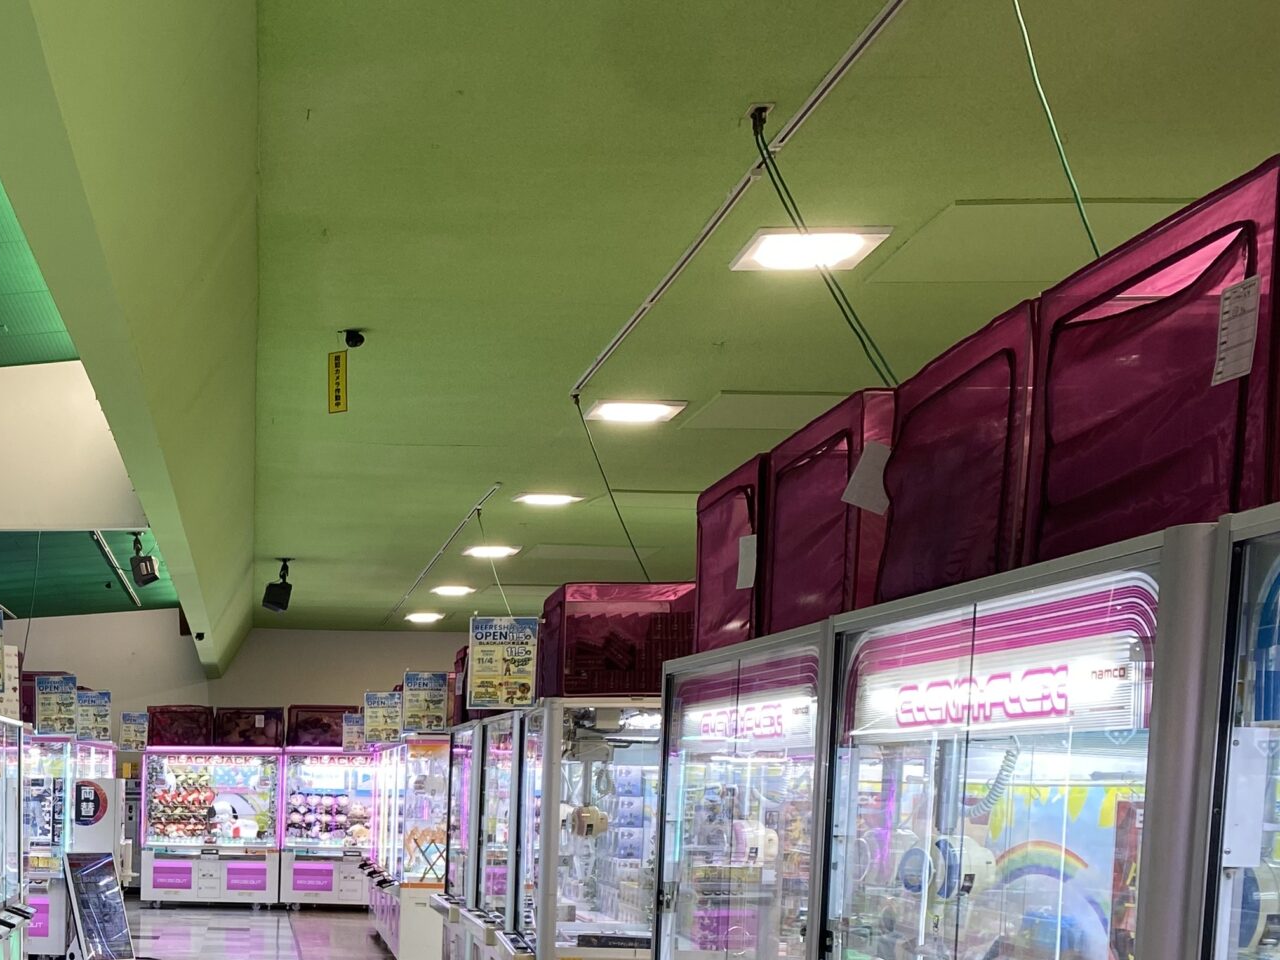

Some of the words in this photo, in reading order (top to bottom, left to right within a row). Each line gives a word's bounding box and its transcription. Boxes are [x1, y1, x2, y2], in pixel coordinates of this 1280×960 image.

[475, 631, 508, 640] OPEN
[1090, 667, 1126, 680] namco
[168, 755, 212, 765] BLACK
[216, 755, 252, 765] JACK
[309, 755, 355, 765] BLACK
[81, 786, 95, 816] 両替
